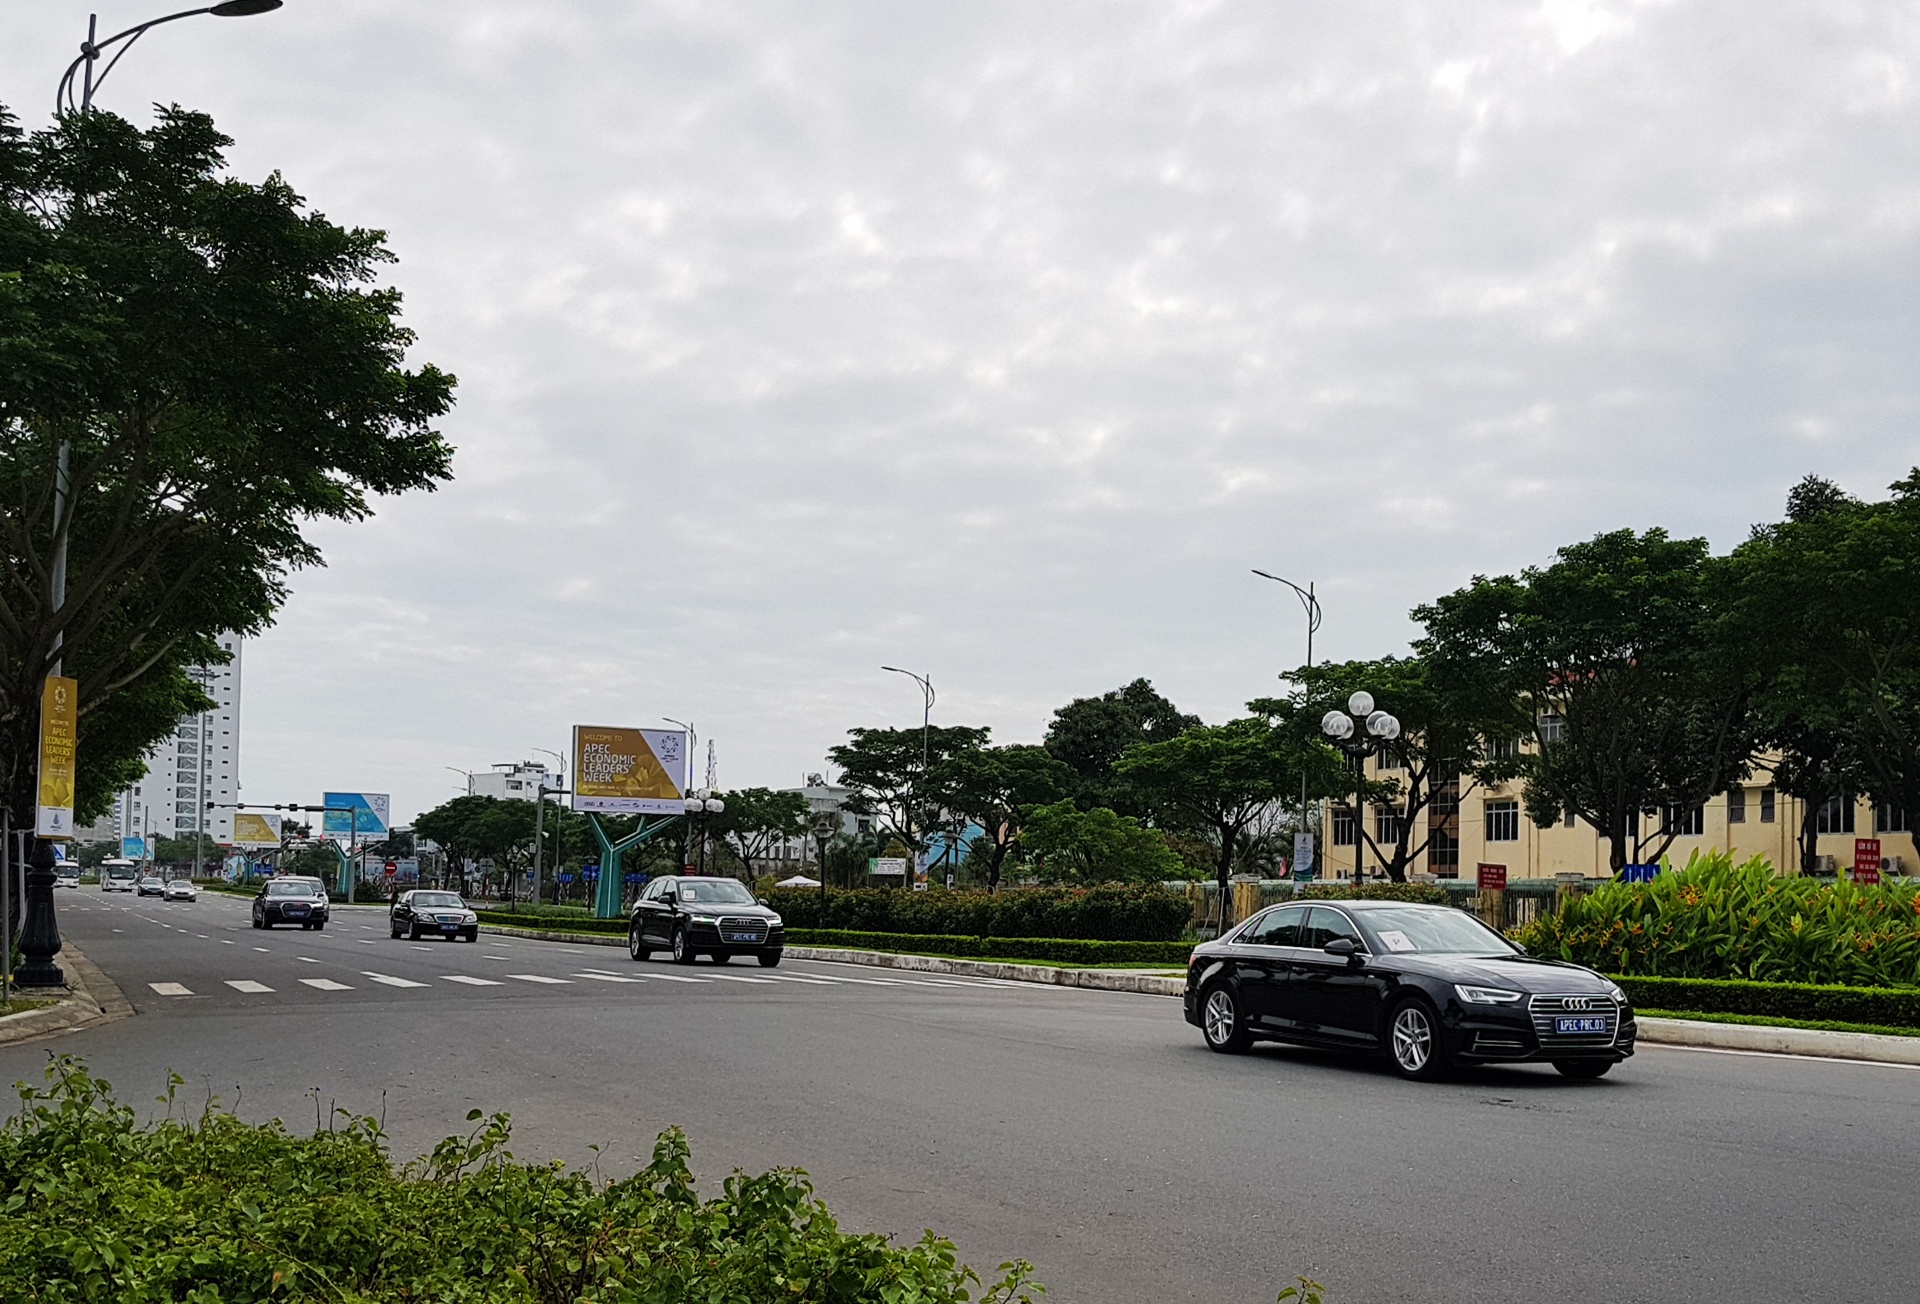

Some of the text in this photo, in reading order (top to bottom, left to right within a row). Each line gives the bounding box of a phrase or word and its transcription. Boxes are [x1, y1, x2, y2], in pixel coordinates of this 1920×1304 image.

[51, 727, 67, 737] APEC
[584, 733, 623, 742] WELCOME TO
[45, 736, 73, 747] ECONOMIC
[584, 743, 611, 754] APEC
[50, 755, 67, 765] WEEK
[583, 753, 637, 765] ECONOMIC
[583, 763, 632, 774] LEADERS'
[583, 772, 612, 783] WEEK
